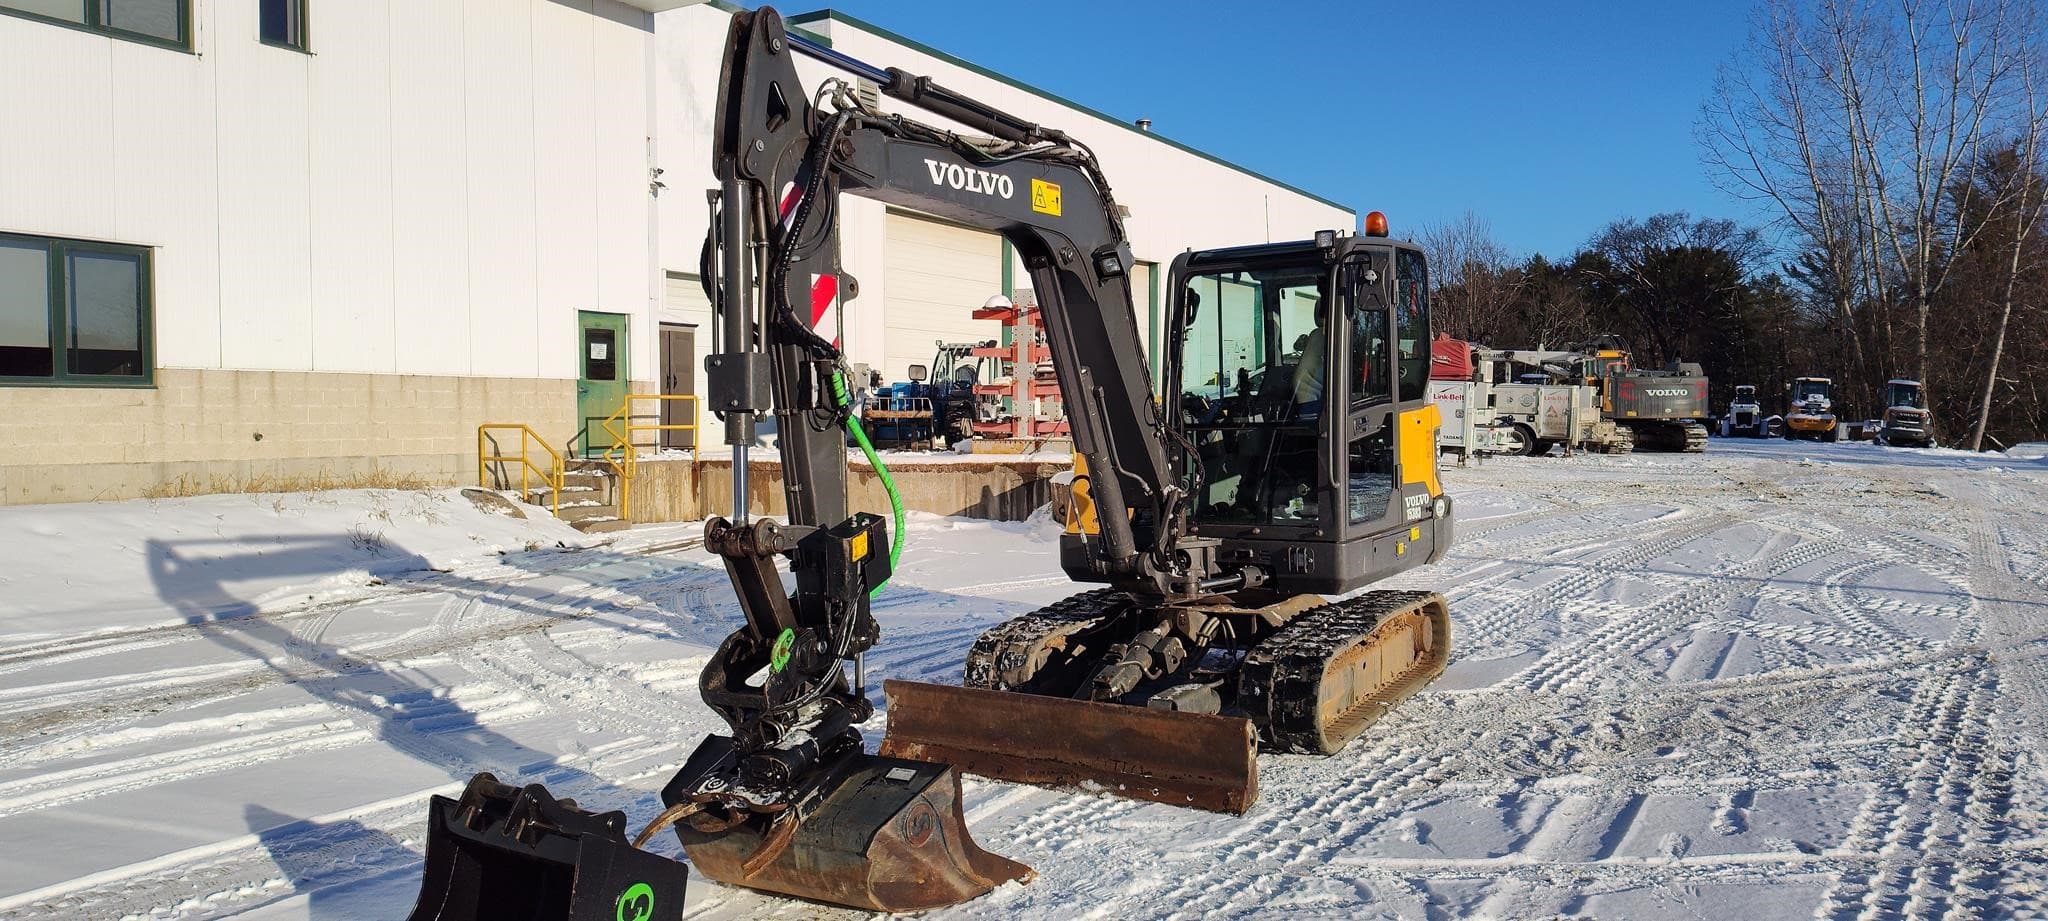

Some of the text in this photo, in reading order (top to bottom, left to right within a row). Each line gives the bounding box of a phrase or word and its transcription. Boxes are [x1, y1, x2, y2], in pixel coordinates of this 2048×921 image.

[924, 158, 1014, 200] VOLVO
[1433, 393, 1465, 401] Link-Belt
[1645, 389, 1688, 397] VOLVO
[1405, 494, 1430, 508] VOLVO
